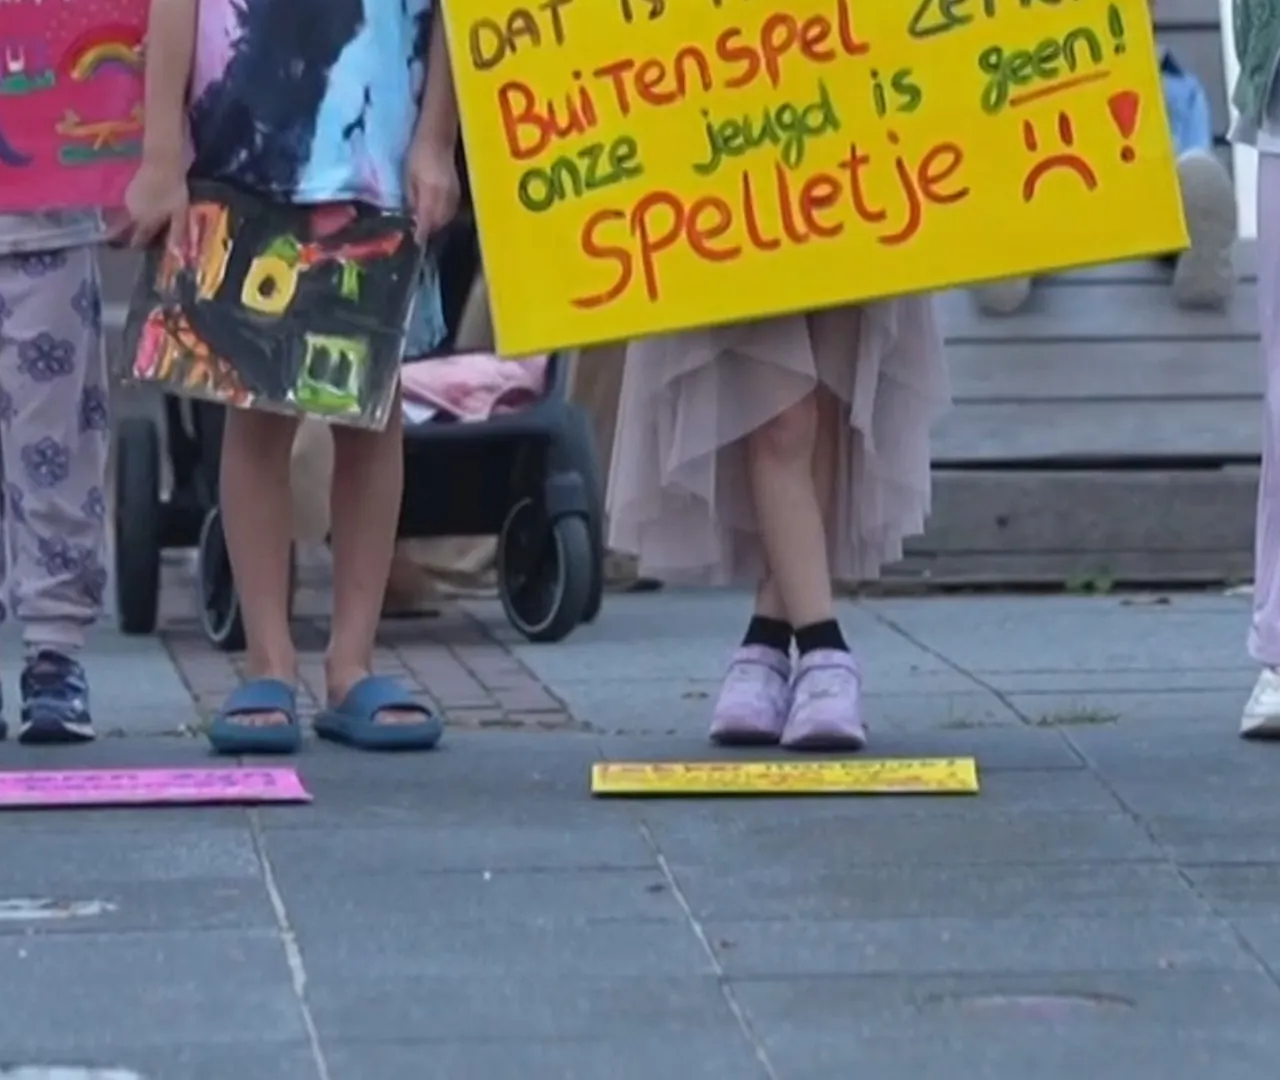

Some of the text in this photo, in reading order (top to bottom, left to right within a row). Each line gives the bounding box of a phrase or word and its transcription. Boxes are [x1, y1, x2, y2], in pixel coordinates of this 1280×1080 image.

[518, 3, 1126, 213] onze jeugd is geen!
